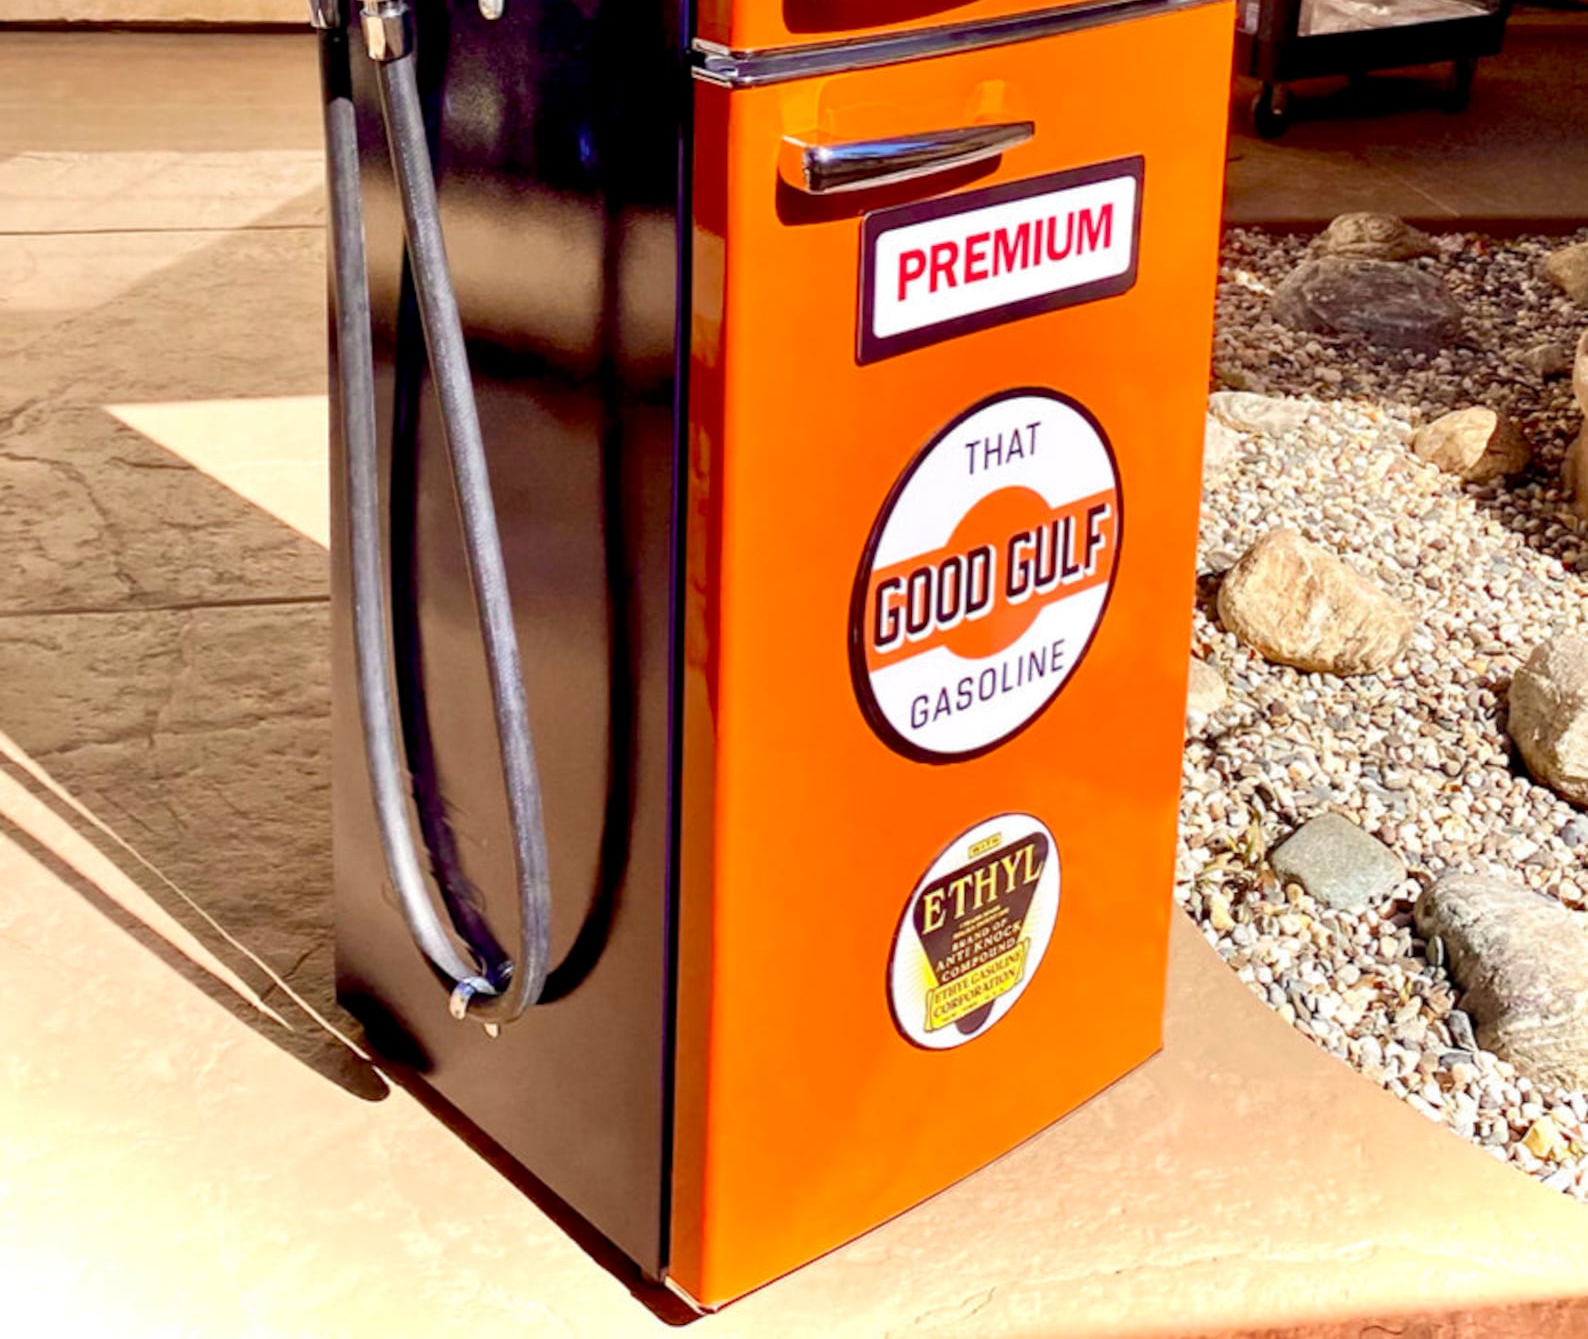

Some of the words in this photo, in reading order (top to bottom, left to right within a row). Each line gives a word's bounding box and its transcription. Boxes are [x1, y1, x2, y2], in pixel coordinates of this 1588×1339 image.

[896, 202, 1114, 303] PREMIUM
[965, 421, 1042, 476] THAT
[873, 544, 996, 654] GOOD
[1005, 502, 1112, 603] GULF
[910, 638, 1067, 730] GASOLINE
[922, 843, 1044, 935] ETHYL
[935, 946, 970, 972] ANTI
[974, 919, 1022, 954] KNOCK
[941, 936, 1017, 982] COMPOUND
[952, 926, 990, 952] BRAND
[992, 917, 1007, 932] OF
[933, 969, 1016, 1018] CORPORATION
